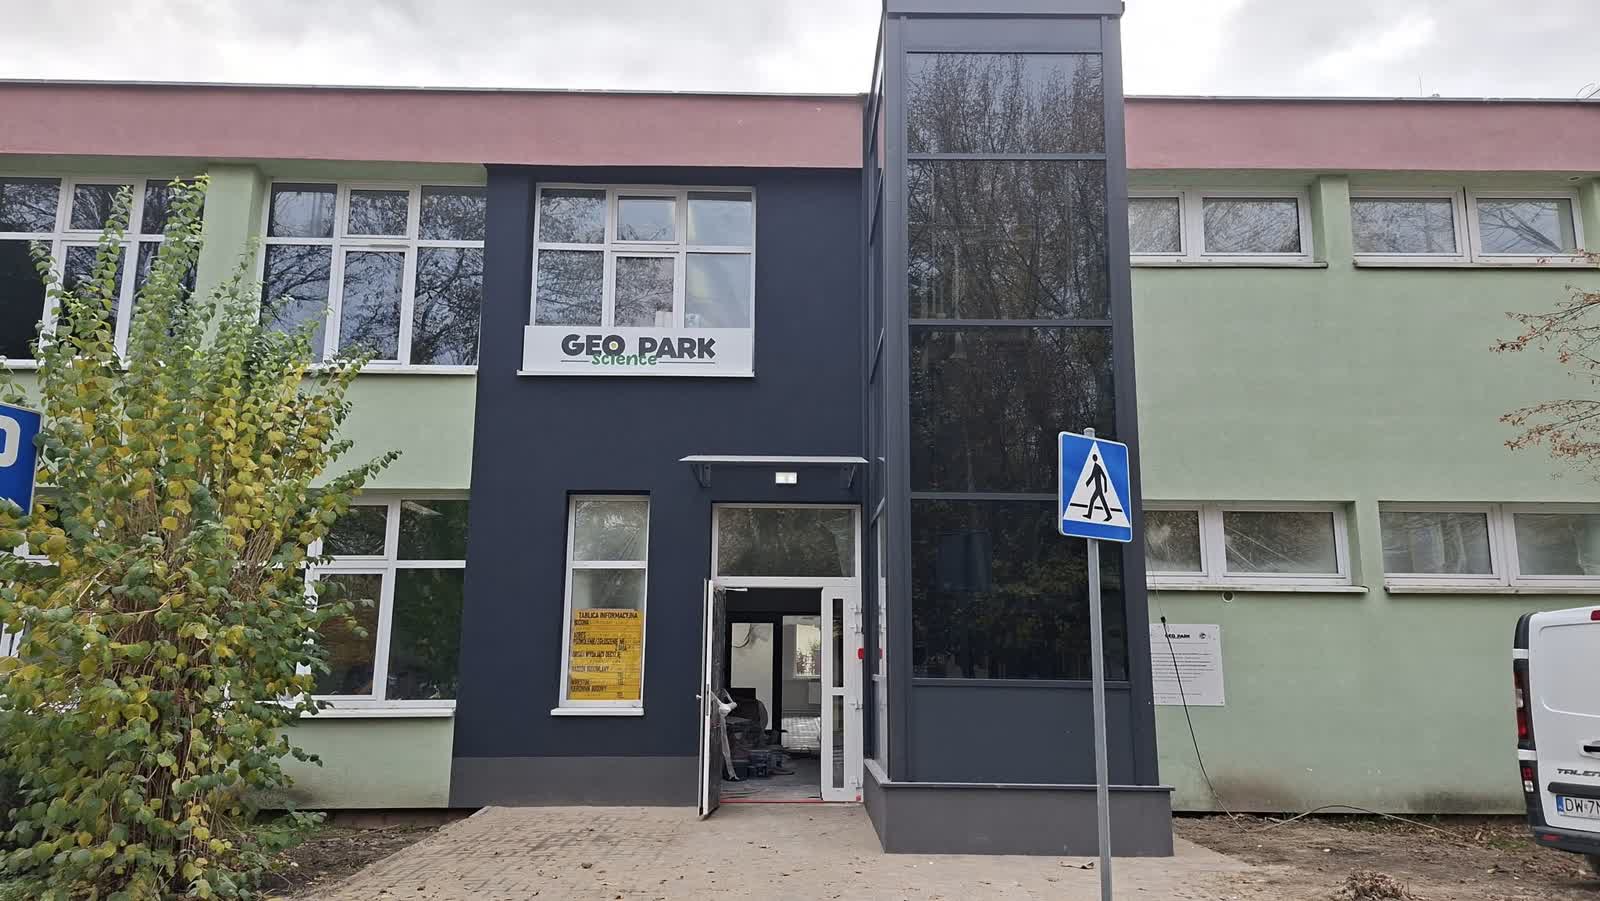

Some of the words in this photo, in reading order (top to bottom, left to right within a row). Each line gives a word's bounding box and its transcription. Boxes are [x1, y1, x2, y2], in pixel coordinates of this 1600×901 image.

[561, 334, 626, 357] GEO
[638, 336, 716, 359] PARK
[591, 352, 657, 366] science
[1565, 798, 1583, 813] DW
